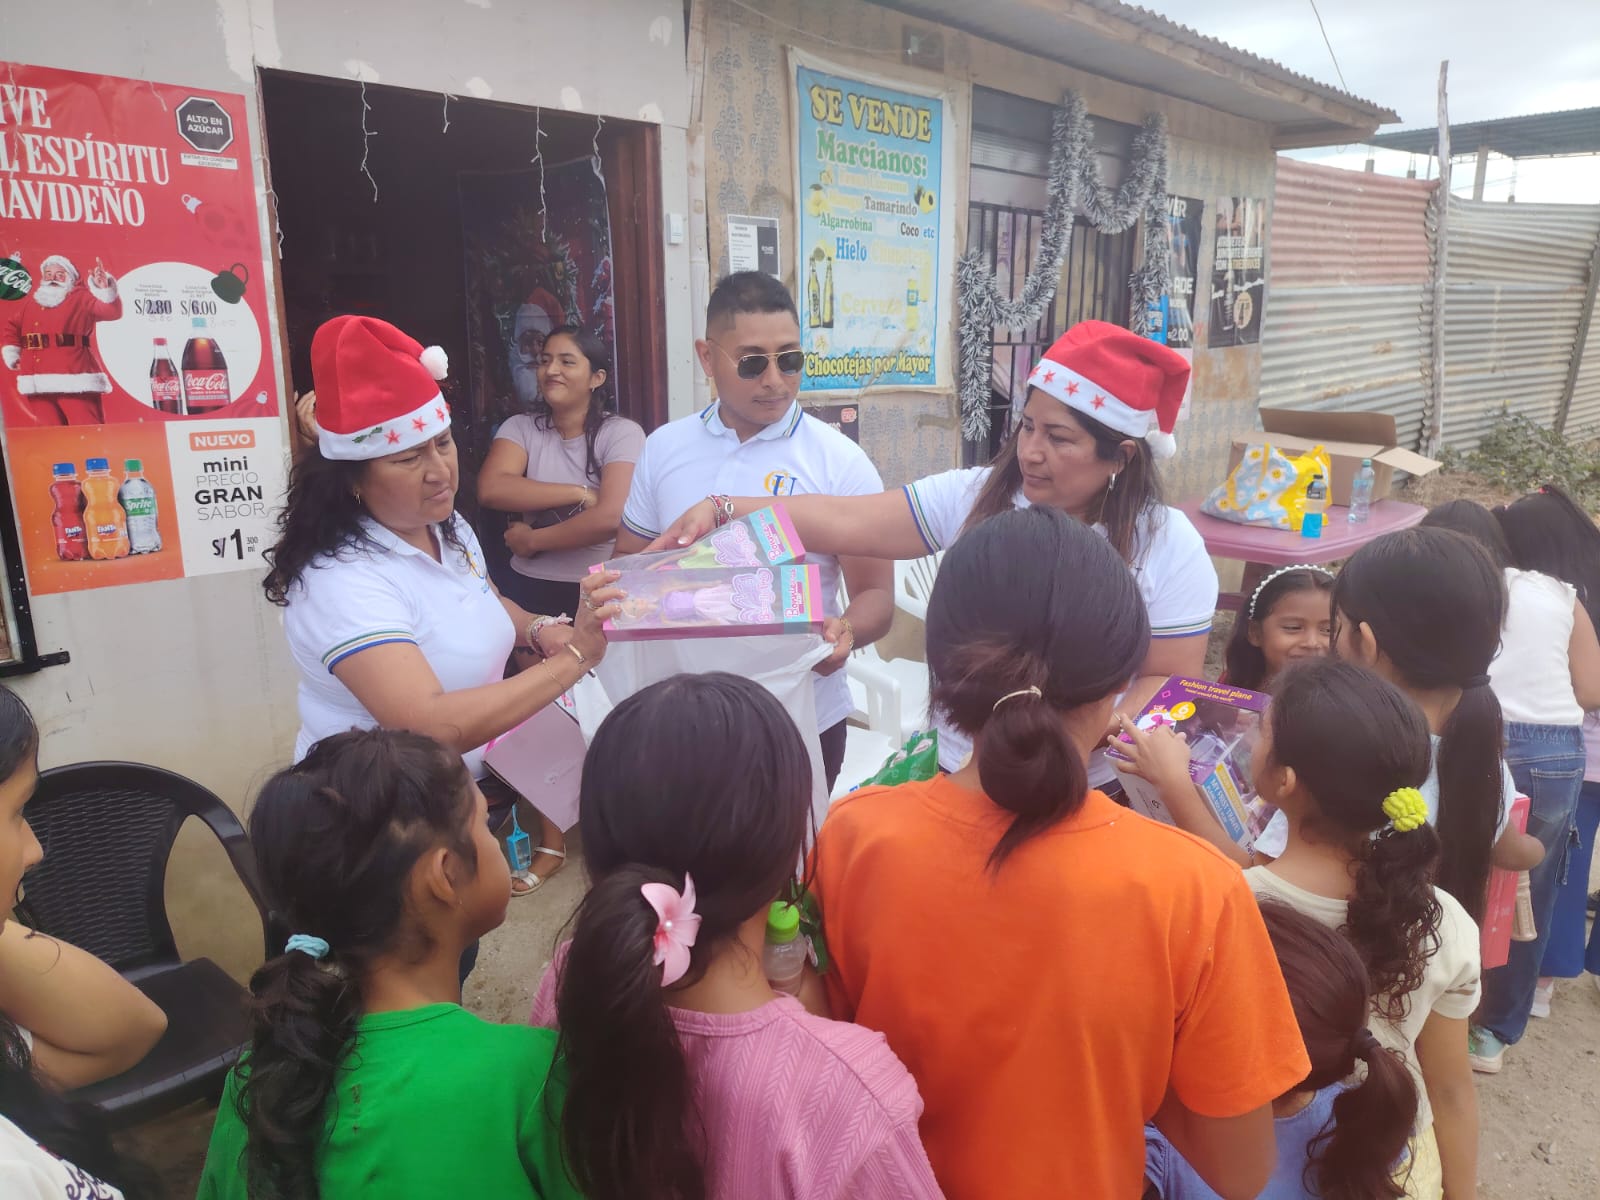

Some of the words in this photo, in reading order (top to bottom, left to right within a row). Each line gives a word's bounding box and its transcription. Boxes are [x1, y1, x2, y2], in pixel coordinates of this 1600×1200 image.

[187, 114, 209, 124] ALTO
[210, 117, 223, 126] EN
[810, 84, 843, 126] SE
[847, 93, 931, 143] VENDE
[187, 124, 224, 135] AZÚCAR
[22, 133, 170, 186] ESPÍRITU
[816, 129, 927, 177] Marcianos:
[863, 195, 918, 217] Tamarindo
[819, 212, 874, 232] Algarrobina
[900, 222, 920, 238] Coco
[923, 227, 935, 239] etc
[835, 236, 867, 262] Hielo
[180, 298, 217, 317] S/6.00
[805, 352, 873, 381] Chocotejas
[873, 356, 897, 378] por
[896, 350, 931, 378] Mayor
[194, 433, 251, 447] NUEVO
[203, 456, 249, 473] mini
[196, 472, 259, 487] PRECIO
[194, 485, 263, 505] GRAN
[197, 502, 267, 521] SABOR
[1179, 679, 1208, 690] Fashion
[1207, 685, 1231, 695] travel
[1229, 690, 1253, 700] plane
